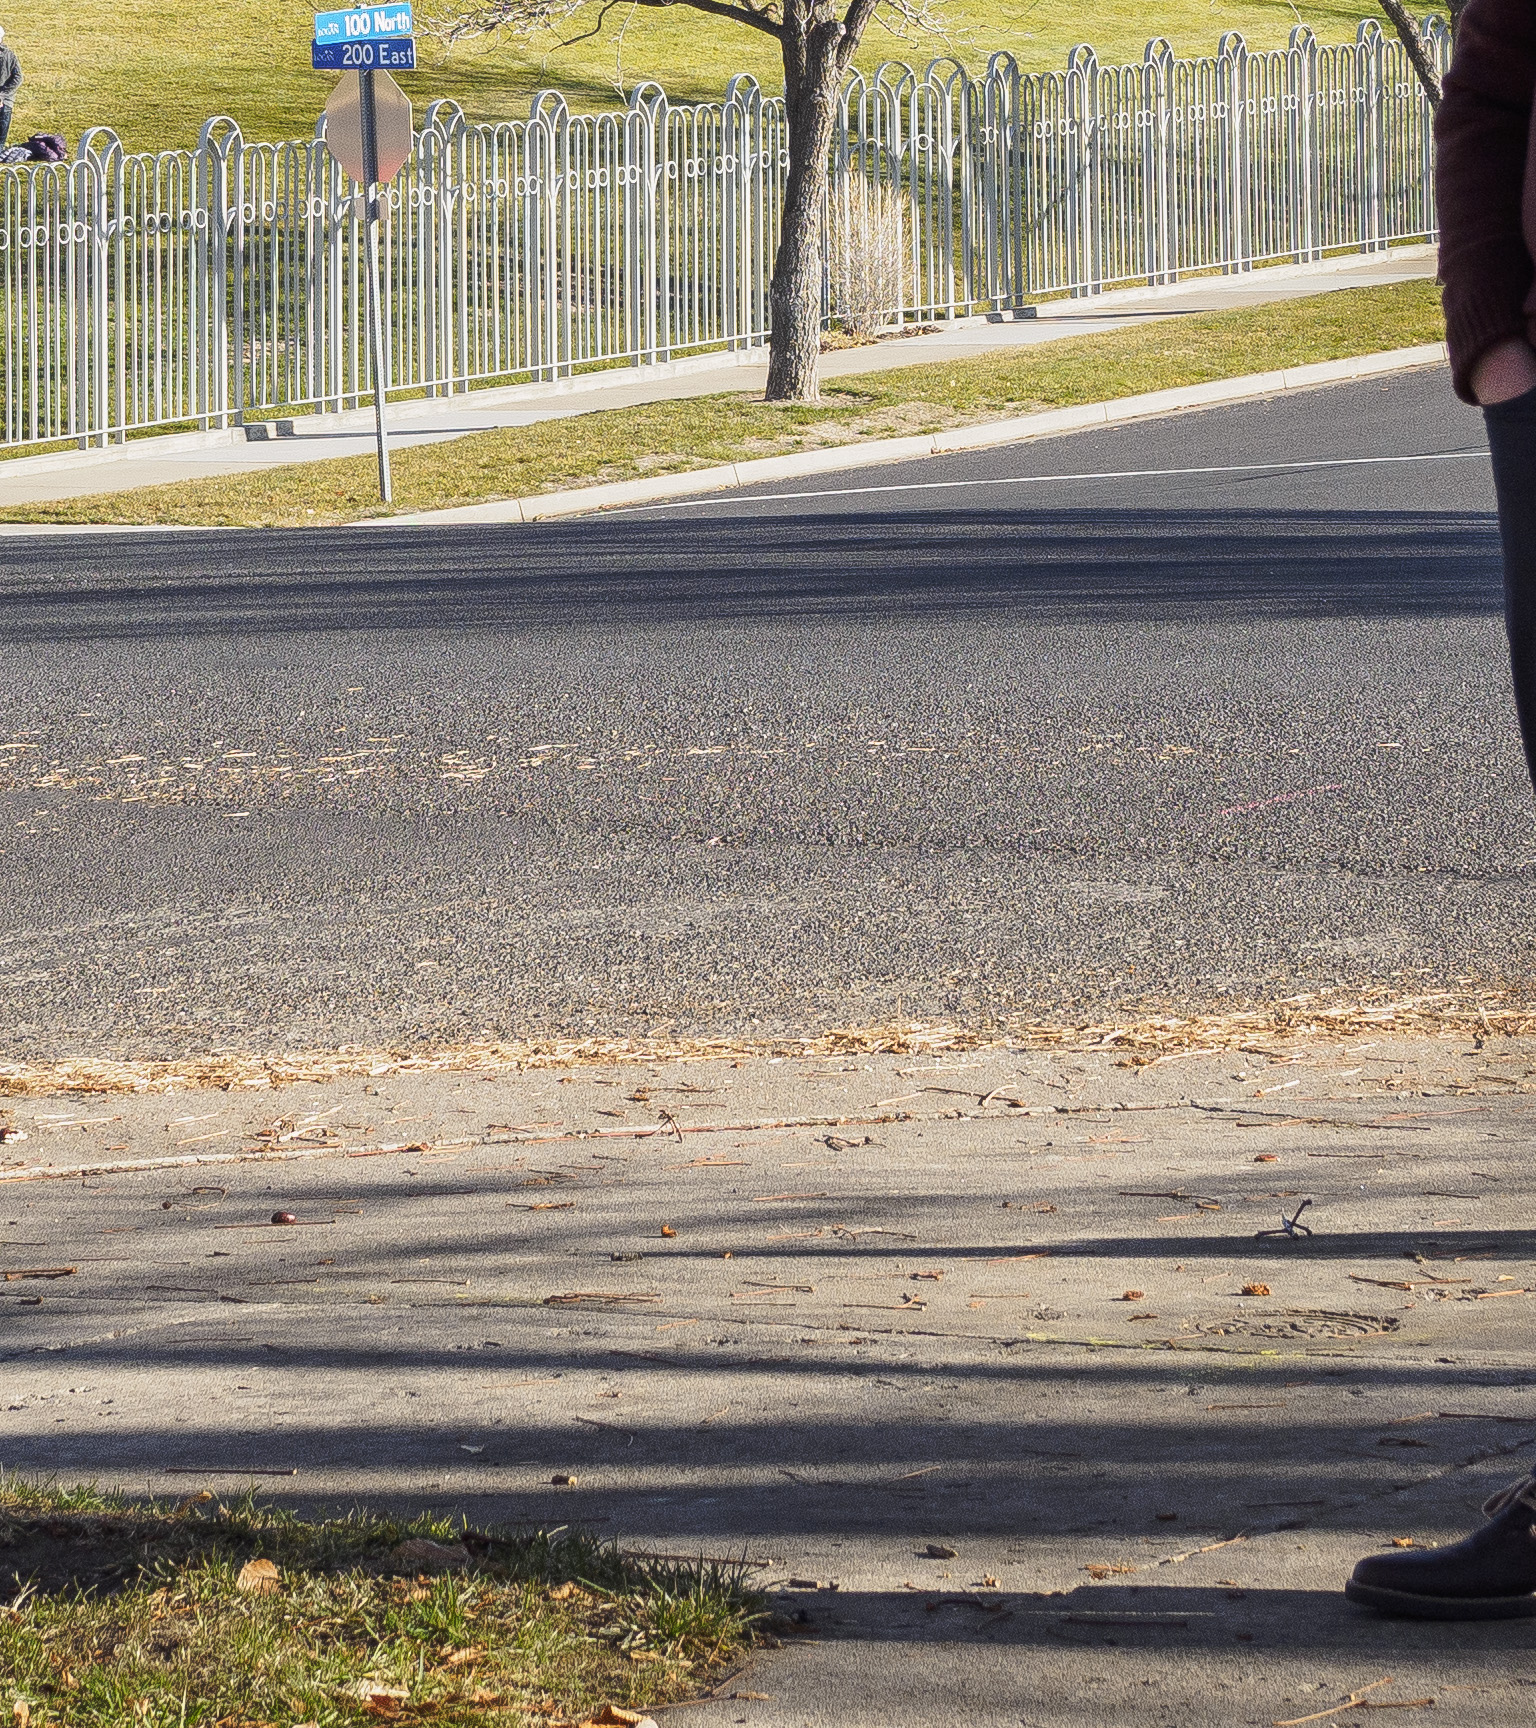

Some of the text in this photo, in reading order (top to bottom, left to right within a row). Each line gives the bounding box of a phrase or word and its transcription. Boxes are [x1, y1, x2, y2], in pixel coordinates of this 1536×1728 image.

[344, 11, 410, 36] 100 North
[342, 44, 412, 64] 200 East
